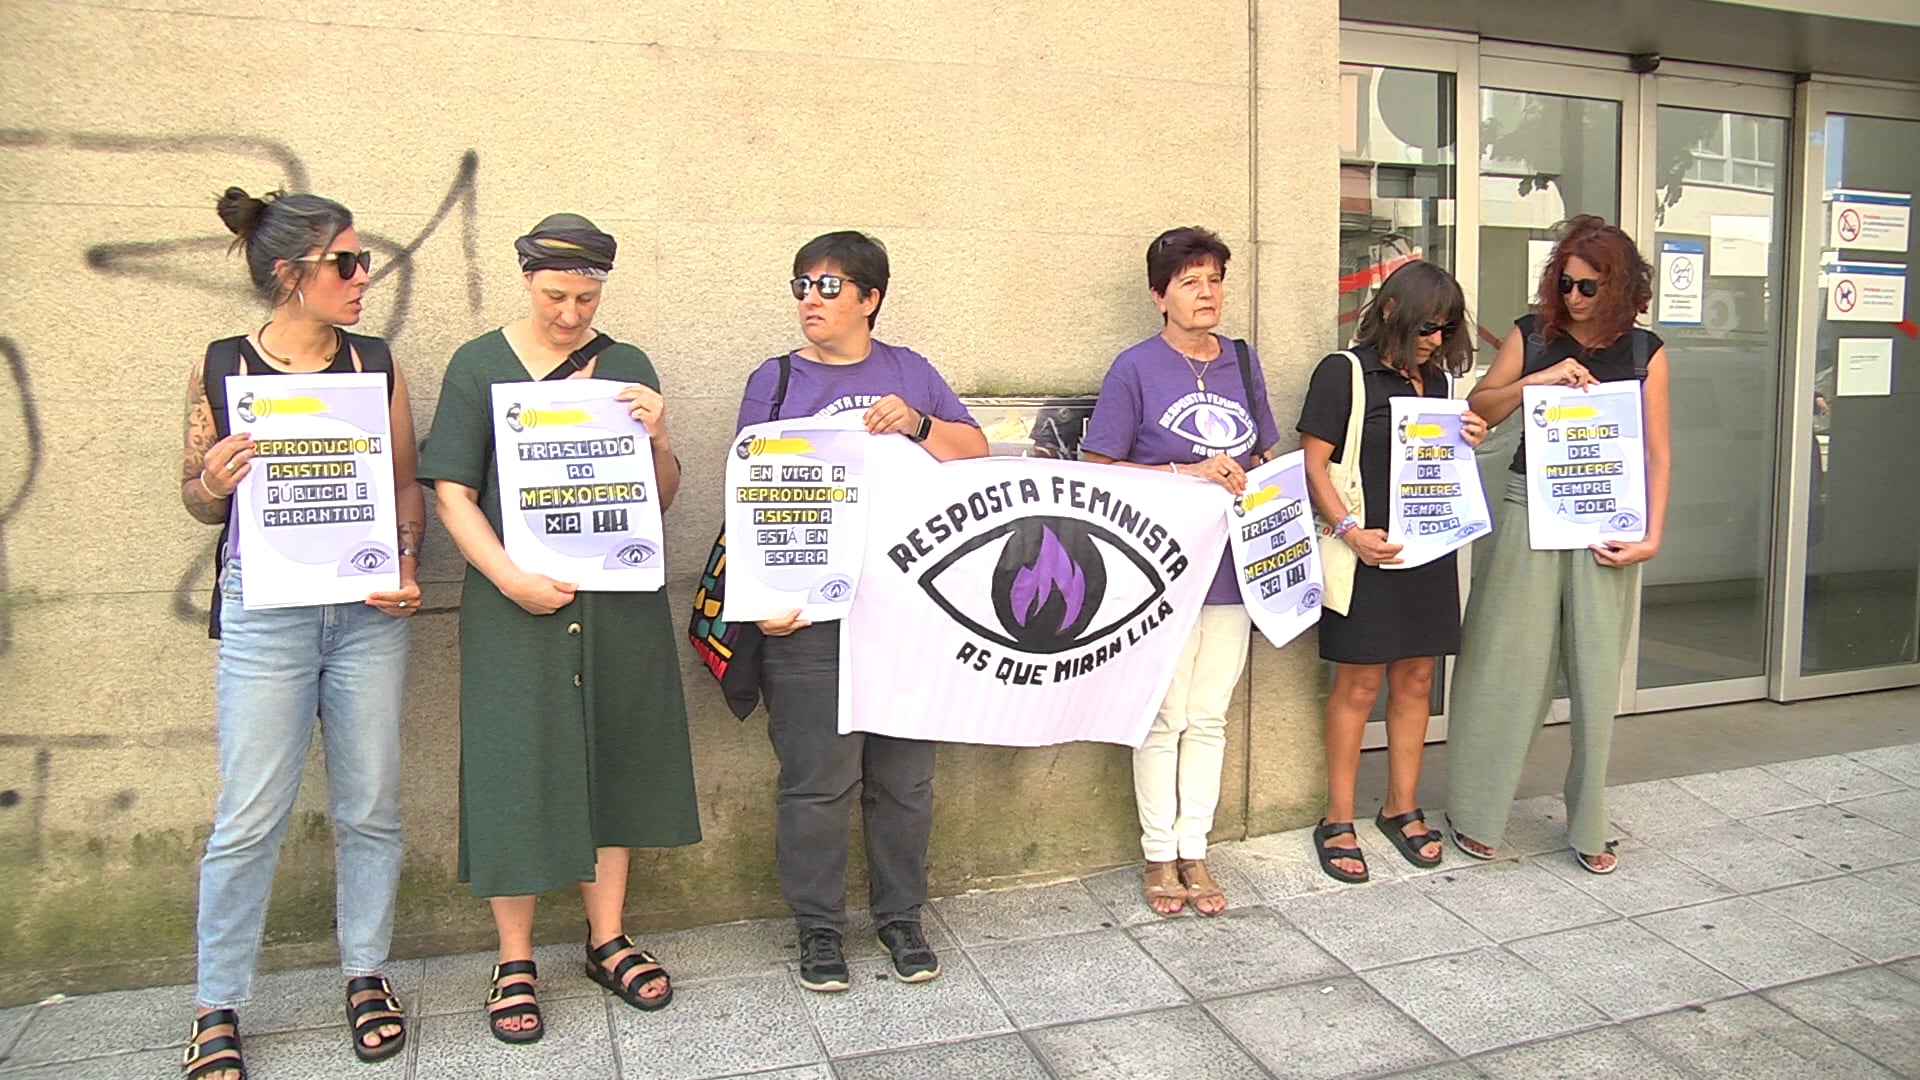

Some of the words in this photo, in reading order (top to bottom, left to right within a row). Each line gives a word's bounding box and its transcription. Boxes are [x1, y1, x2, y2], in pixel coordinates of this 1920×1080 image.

[1548, 429, 1559, 442] A
[1567, 424, 1619, 440] SAÚDE
[518, 437, 634, 460] TRASLADO
[1405, 447, 1413, 460] A
[1417, 444, 1454, 461] SAÚDE
[1568, 445, 1600, 459] DAS
[268, 462, 355, 480] ASISTIDA
[568, 464, 594, 478] AO
[750, 466, 773, 481] EN
[782, 466, 822, 481] VIGO
[832, 466, 845, 481] A
[1417, 465, 1441, 479] DAS
[1547, 462, 1622, 478] MULLERES
[268, 483, 346, 503] PÚBLICA
[357, 483, 367, 499] E
[520, 484, 646, 509] MEIXOEIRO
[737, 485, 858, 502] REPRODUCIÓN
[1401, 484, 1461, 498] MULLERES
[1552, 481, 1611, 496] SEMPRE
[1404, 503, 1452, 517] SEMPRE
[1575, 498, 1616, 514] COLA
[264, 505, 374, 525] GARANTIDA
[546, 515, 580, 532] XA
[754, 508, 832, 524] ASISTIDA
[1242, 501, 1303, 541] TRASLADO
[887, 478, 1040, 573] RESPOSTA
[1051, 476, 1189, 582] FEMINISTA
[1419, 517, 1460, 535] COLA
[757, 527, 798, 545] ESTÁ
[806, 529, 828, 544] EN
[1271, 532, 1287, 549] AO
[765, 550, 828, 565] ESPERA
[1244, 537, 1312, 583] MEIXOEIRO
[1260, 576, 1281, 600] XA
[956, 641, 992, 672] AS
[995, 656, 1047, 685] QUE
[1053, 636, 1123, 683] MIRAN
